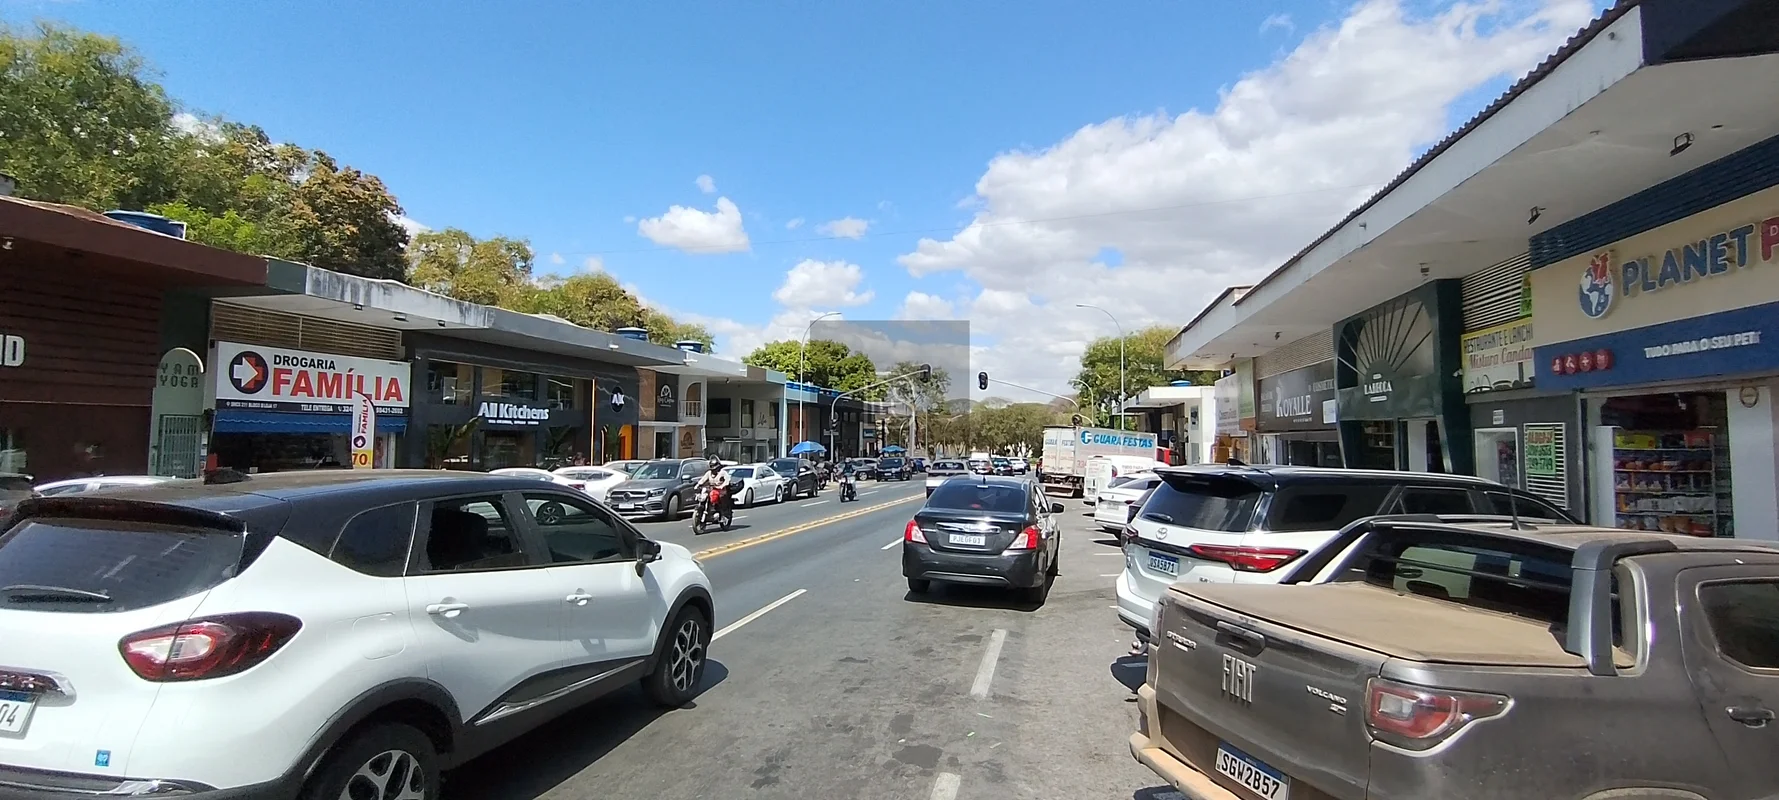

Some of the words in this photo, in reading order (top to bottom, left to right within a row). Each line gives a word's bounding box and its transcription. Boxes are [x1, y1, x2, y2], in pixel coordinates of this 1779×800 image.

[1622, 222, 1755, 297] PLANET
[1644, 345, 1671, 359] TUDO
[1671, 340, 1699, 355] PARA
[1700, 338, 1709, 351] O
[1712, 335, 1732, 349] SEU
[160, 363, 199, 374] YAM
[273, 354, 336, 371] DROGARIA
[160, 374, 199, 388] YOGA
[272, 367, 404, 402] FAMÍLIA
[301, 404, 312, 412] TELE
[360, 399, 370, 434] FAMÍLIA
[478, 402, 498, 418] All
[499, 404, 549, 420] Kitchens
[1122, 436, 1153, 448] FESTAS
[1221, 653, 1256, 703] FIAT
[1306, 684, 1347, 705] VOLCANO
[1221, 753, 1280, 800] SGW2B57
